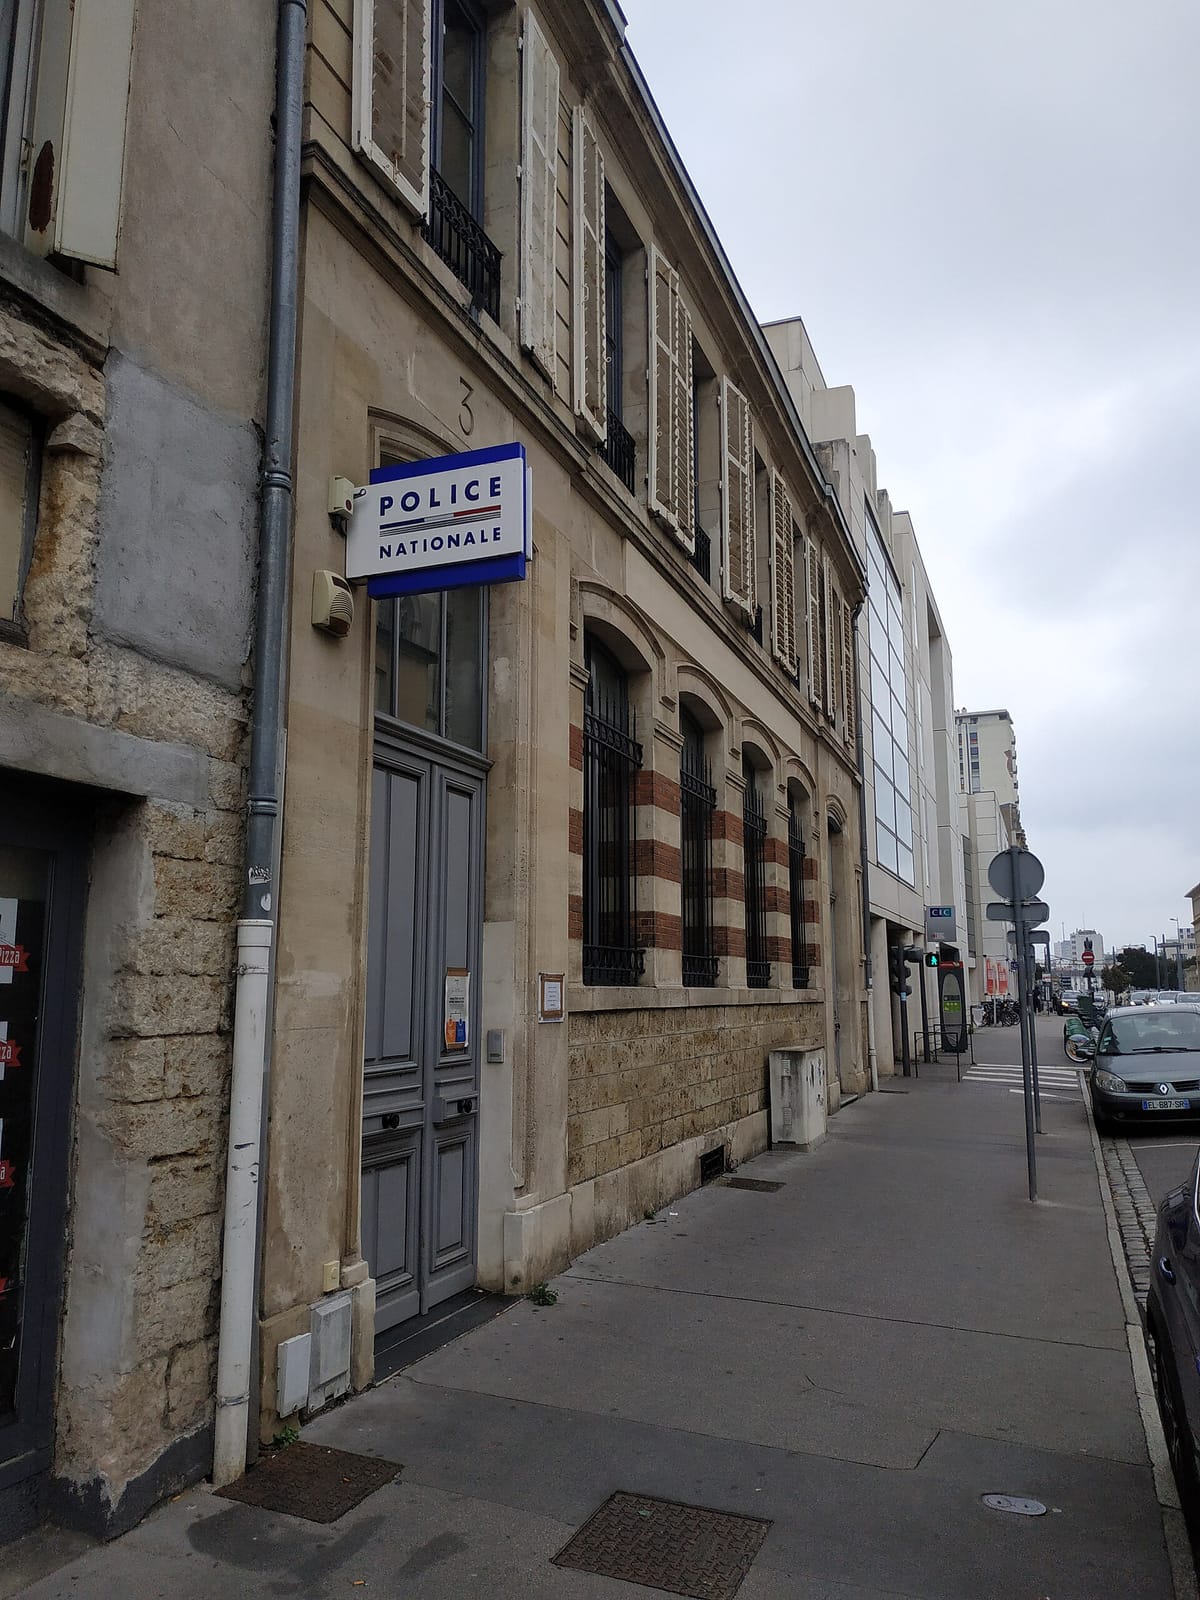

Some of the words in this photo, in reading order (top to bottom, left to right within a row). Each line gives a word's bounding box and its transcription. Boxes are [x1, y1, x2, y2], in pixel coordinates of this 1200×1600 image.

[458, 376, 474, 436] 3
[380, 476, 501, 516] POLICE
[379, 527, 501, 559] NATIONALE
[931, 908, 950, 917] CIC
